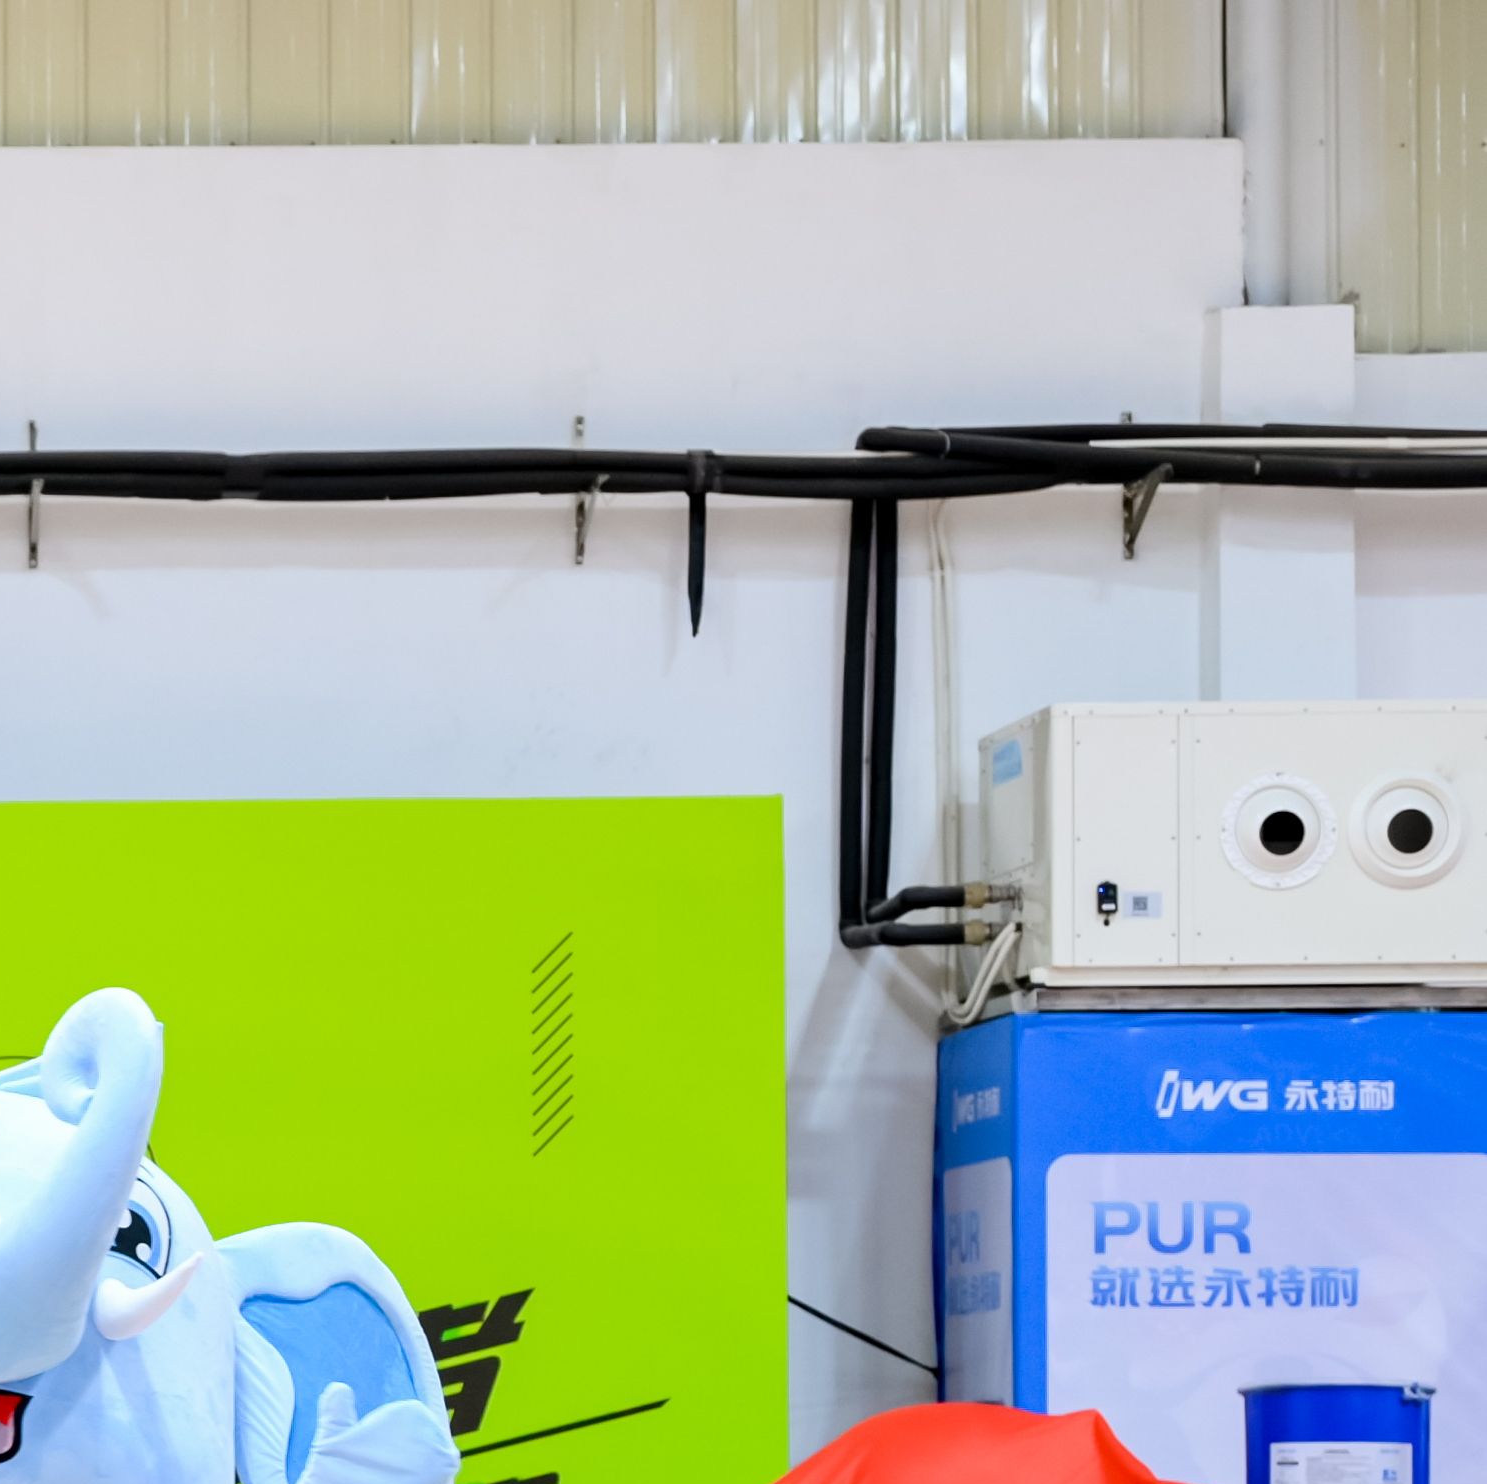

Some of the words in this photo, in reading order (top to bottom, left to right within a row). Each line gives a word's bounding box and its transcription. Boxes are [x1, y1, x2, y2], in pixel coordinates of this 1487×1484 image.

[1285, 1080, 1395, 1111] 永特耐
[1094, 1201, 1252, 1254] PUR
[1089, 1265, 1360, 1308] 就选永特耐
